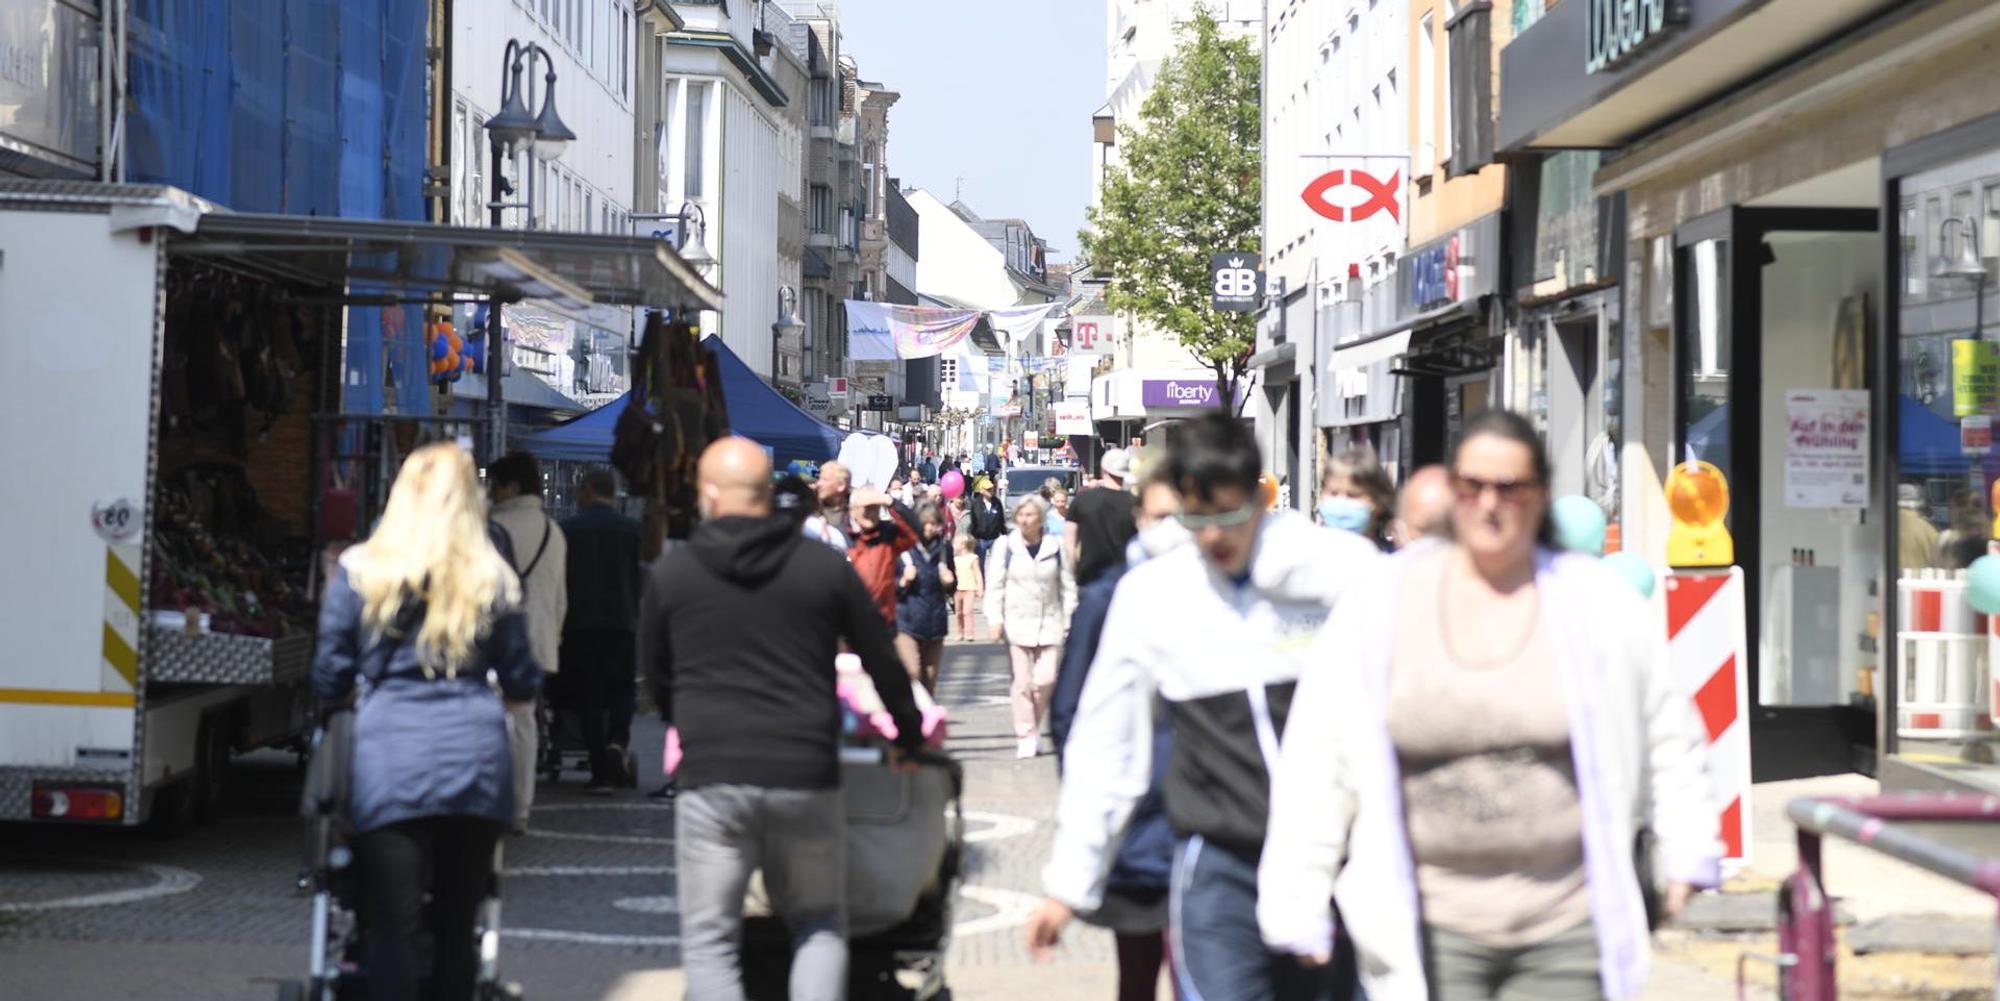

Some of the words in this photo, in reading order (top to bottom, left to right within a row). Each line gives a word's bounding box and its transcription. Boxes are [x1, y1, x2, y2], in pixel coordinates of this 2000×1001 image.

[1215, 268, 1257, 296] BB
[1077, 322, 1098, 350] T
[1166, 381, 1213, 402] liberty
